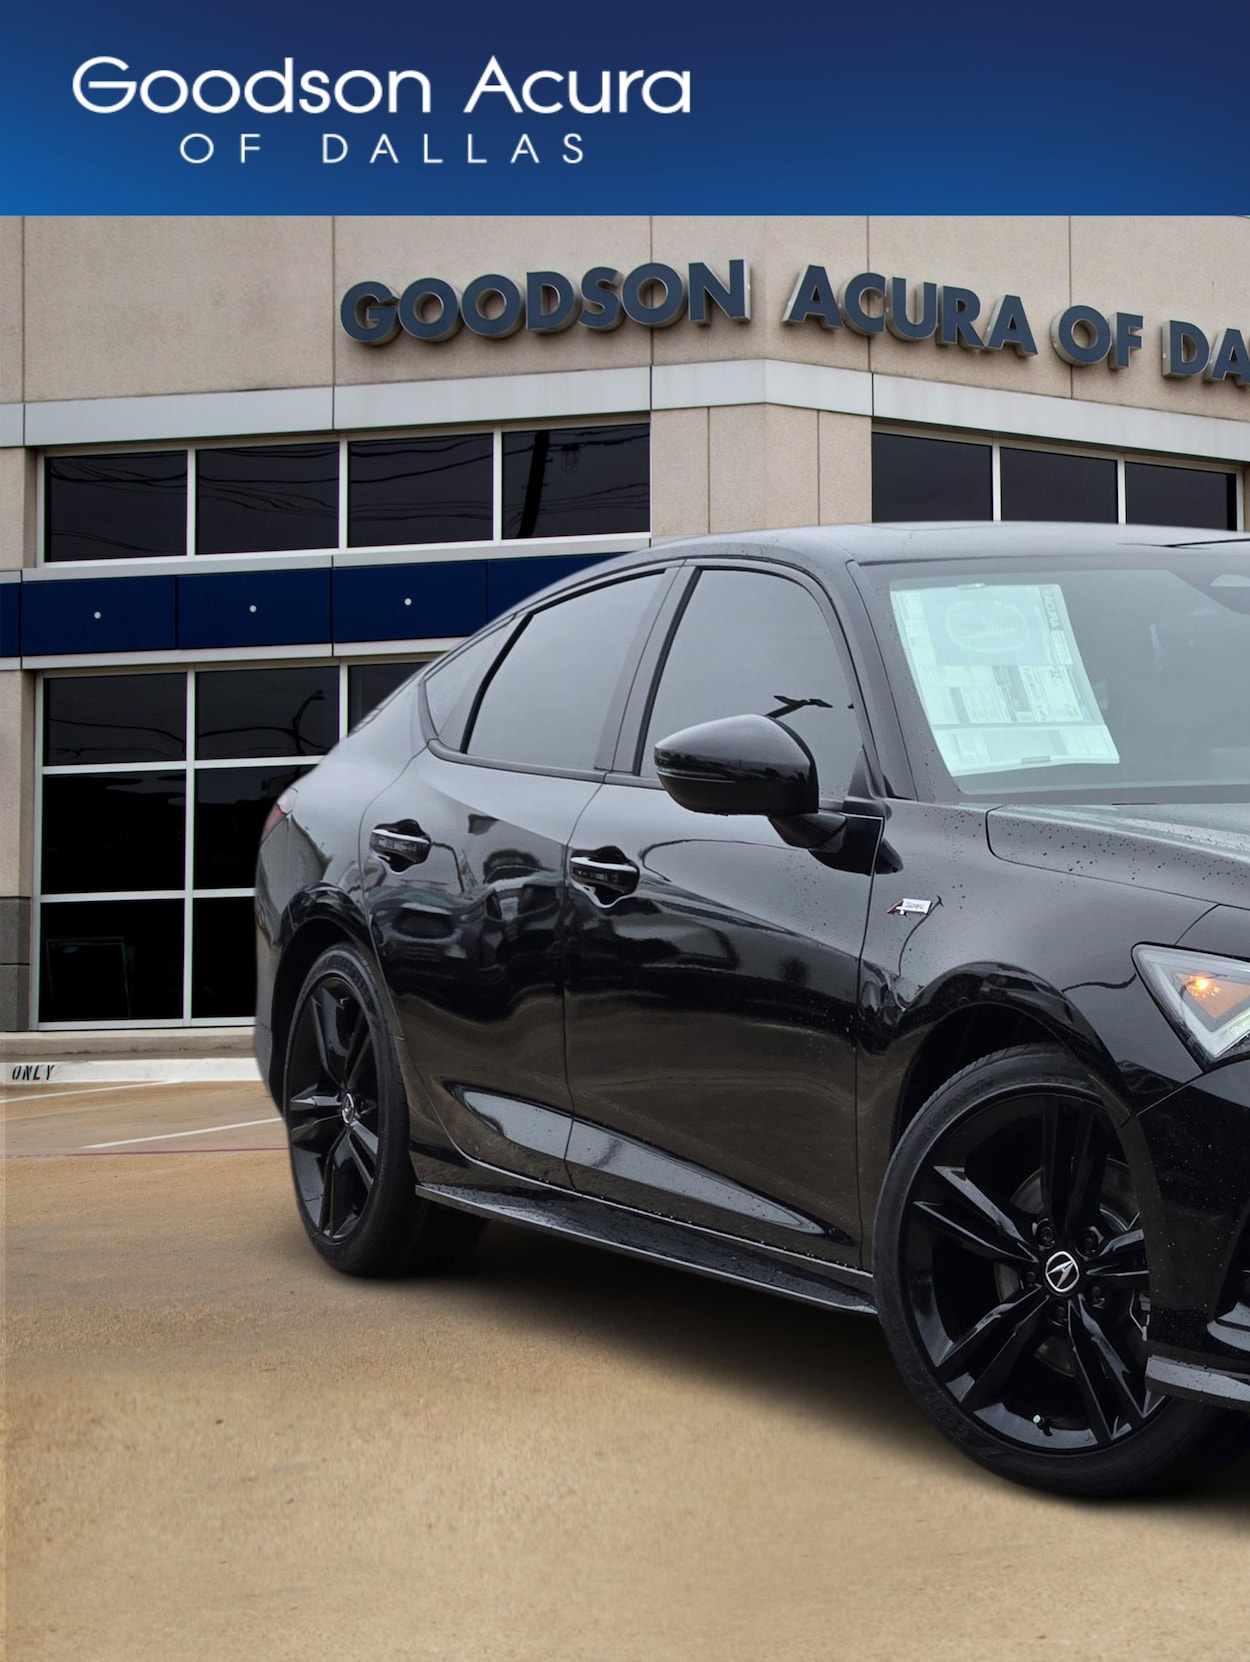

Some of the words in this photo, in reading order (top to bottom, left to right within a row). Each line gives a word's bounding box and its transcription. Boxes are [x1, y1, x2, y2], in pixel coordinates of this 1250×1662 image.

[340, 259, 751, 345] GOODSON
[783, 264, 1038, 356] ACURA
[1052, 305, 1144, 370] OF
[11, 1064, 55, 1081] ONLY
